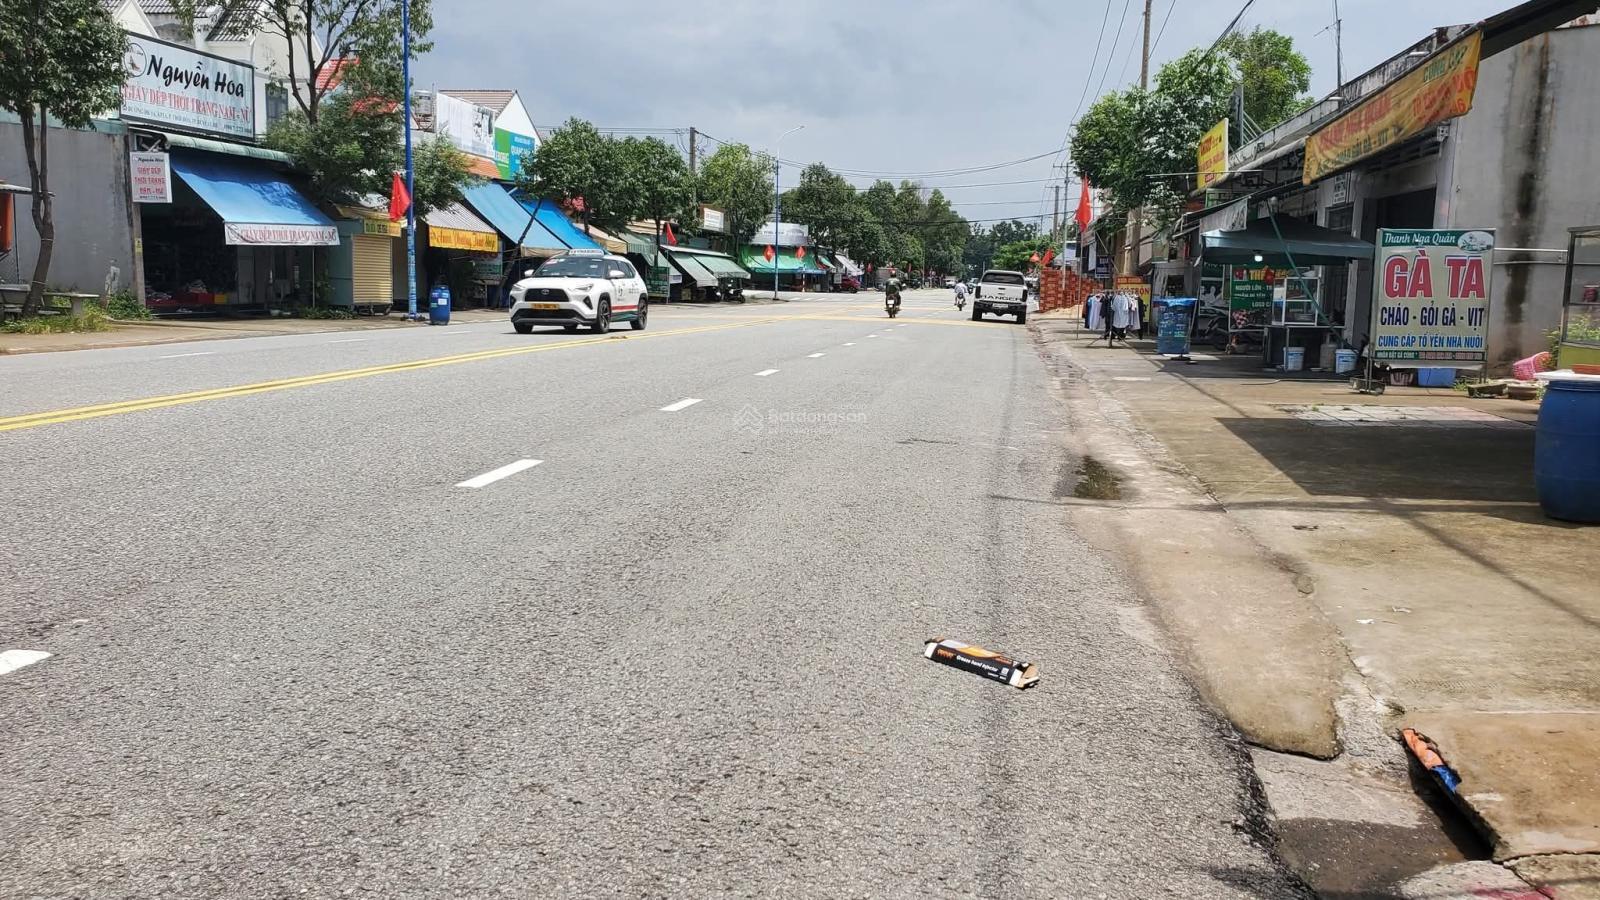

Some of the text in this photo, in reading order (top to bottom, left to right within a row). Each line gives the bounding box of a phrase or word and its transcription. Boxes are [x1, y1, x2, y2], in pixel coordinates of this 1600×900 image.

[147, 55, 244, 97] Nguyễn Hoa
[1384, 233, 1410, 244] Thanh
[1412, 233, 1430, 247] Nga
[1384, 249, 1486, 298] GÀ TA
[1380, 303, 1410, 326] CHÁO
[1420, 300, 1439, 326] GỎI
[1442, 303, 1456, 326] GÀ
[1468, 307, 1485, 331] VỊT
[1378, 335, 1399, 347] CUNG
[1401, 332, 1416, 347] CẤP
[1430, 331, 1444, 347] YẾN
[1464, 333, 1483, 348] NUÔI
